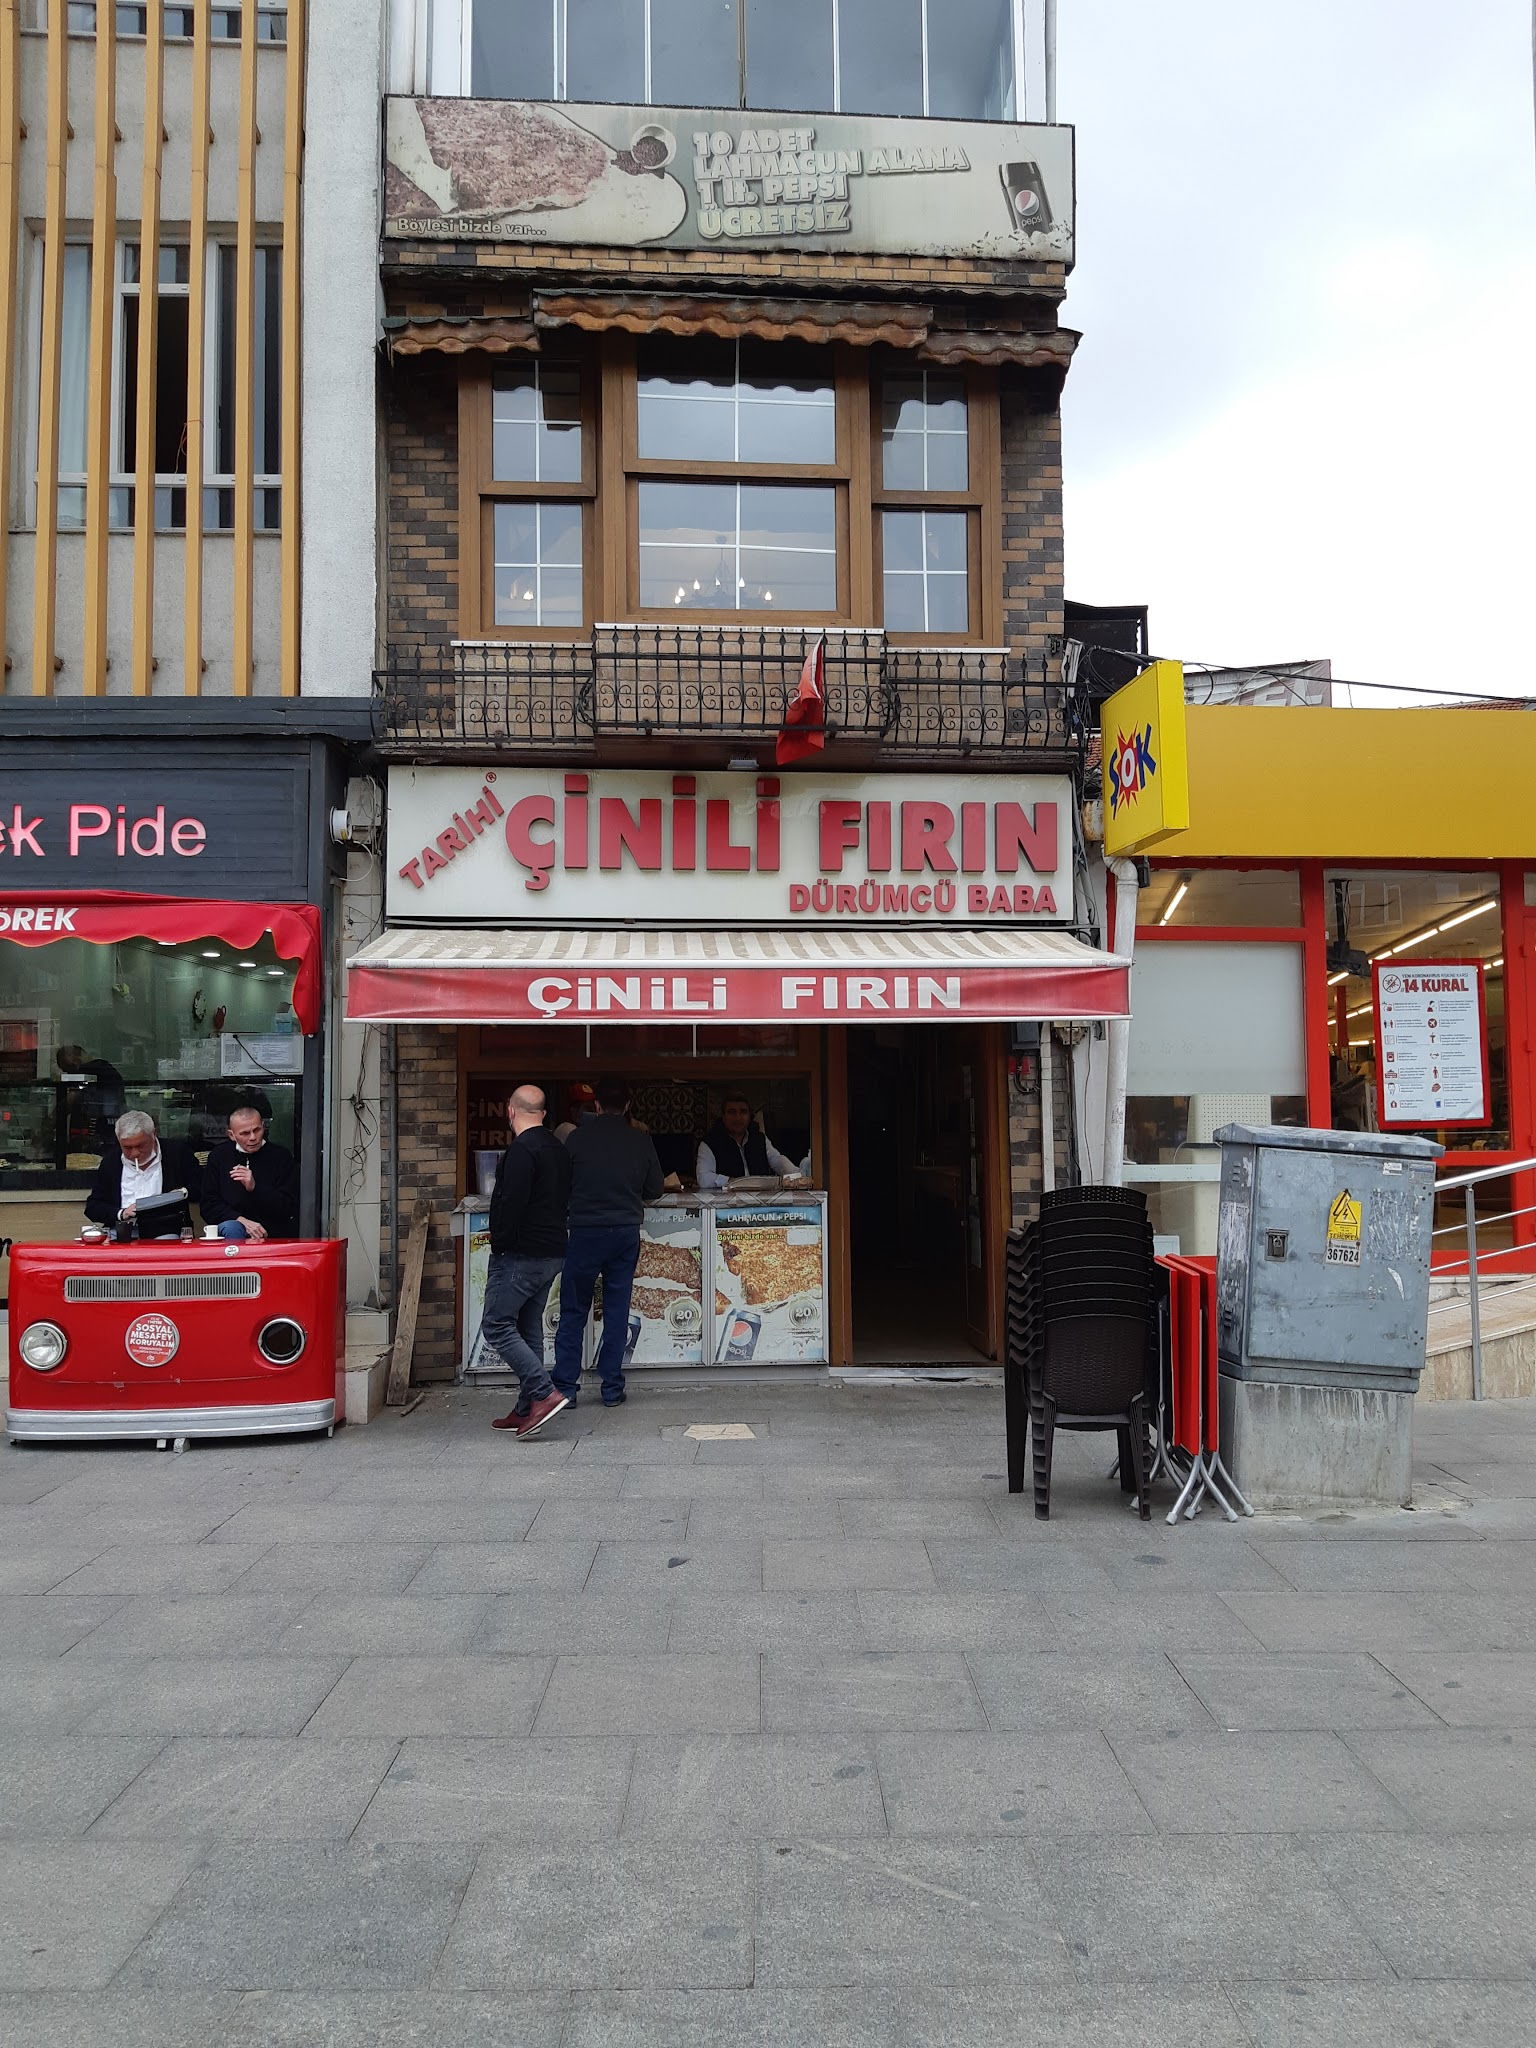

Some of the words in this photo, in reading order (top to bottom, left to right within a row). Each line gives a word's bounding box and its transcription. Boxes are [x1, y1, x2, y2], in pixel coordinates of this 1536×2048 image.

[694, 131, 733, 157] 10
[738, 128, 814, 155] ADET
[695, 150, 862, 181] LAHMACUN
[866, 147, 971, 174] ALANA
[397, 218, 454, 235] Böylesi
[459, 219, 501, 234] bizde
[506, 224, 547, 236] var...
[698, 203, 850, 239] ÜCRETSİZ
[69, 803, 207, 857] Pide
[399, 785, 505, 889] TARİHİ
[505, 774, 780, 891] ÇİNİLİ
[819, 801, 1058, 873] FIRIN
[789, 879, 956, 913] DÜRÜMCÜ
[967, 884, 1057, 913] BABA
[781, 976, 961, 1009] FIRIN
[1402, 979, 1419, 993] 14
[1421, 978, 1469, 993] KURAL
[1327, 1248, 1359, 1263] 367624
[136, 1323, 173, 1334] SOSYAL
[676, 1310, 693, 1320] 20
